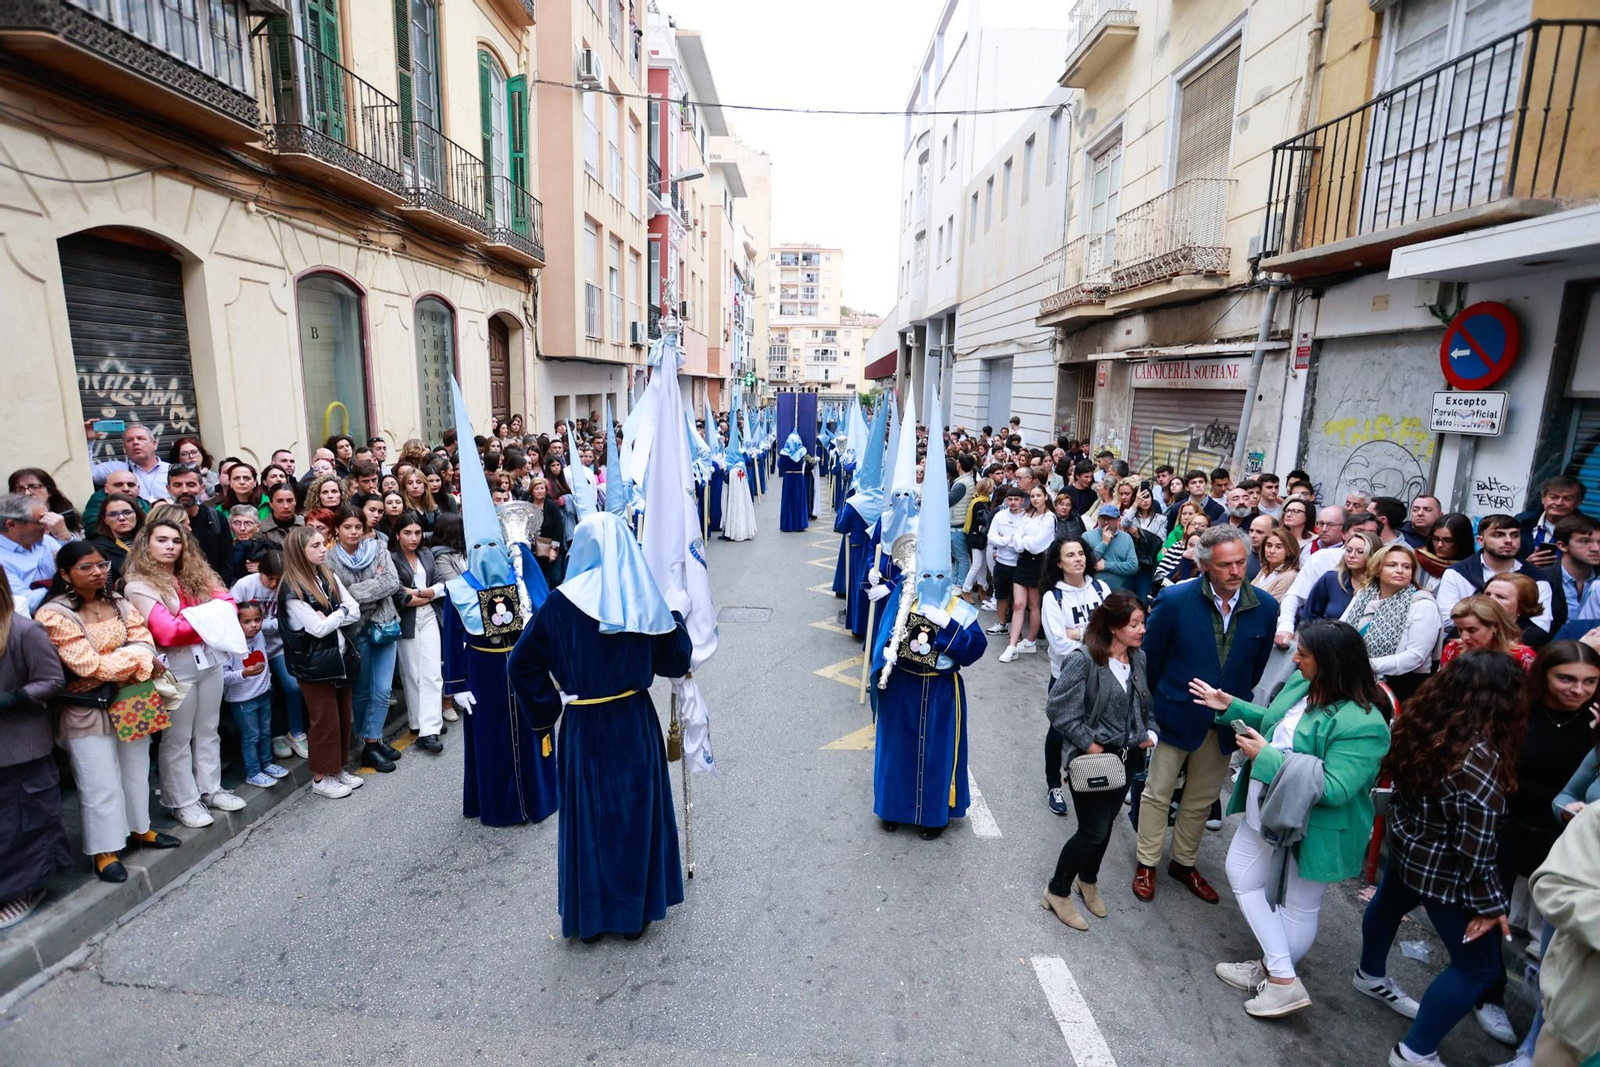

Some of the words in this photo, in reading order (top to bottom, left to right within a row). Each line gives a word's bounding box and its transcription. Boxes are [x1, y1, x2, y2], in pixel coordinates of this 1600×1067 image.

[310, 326, 319, 340] B
[1135, 361, 1191, 380] CARNICERIA
[1194, 363, 1240, 380] SOUFIANE
[1445, 396, 1487, 407] Excepto
